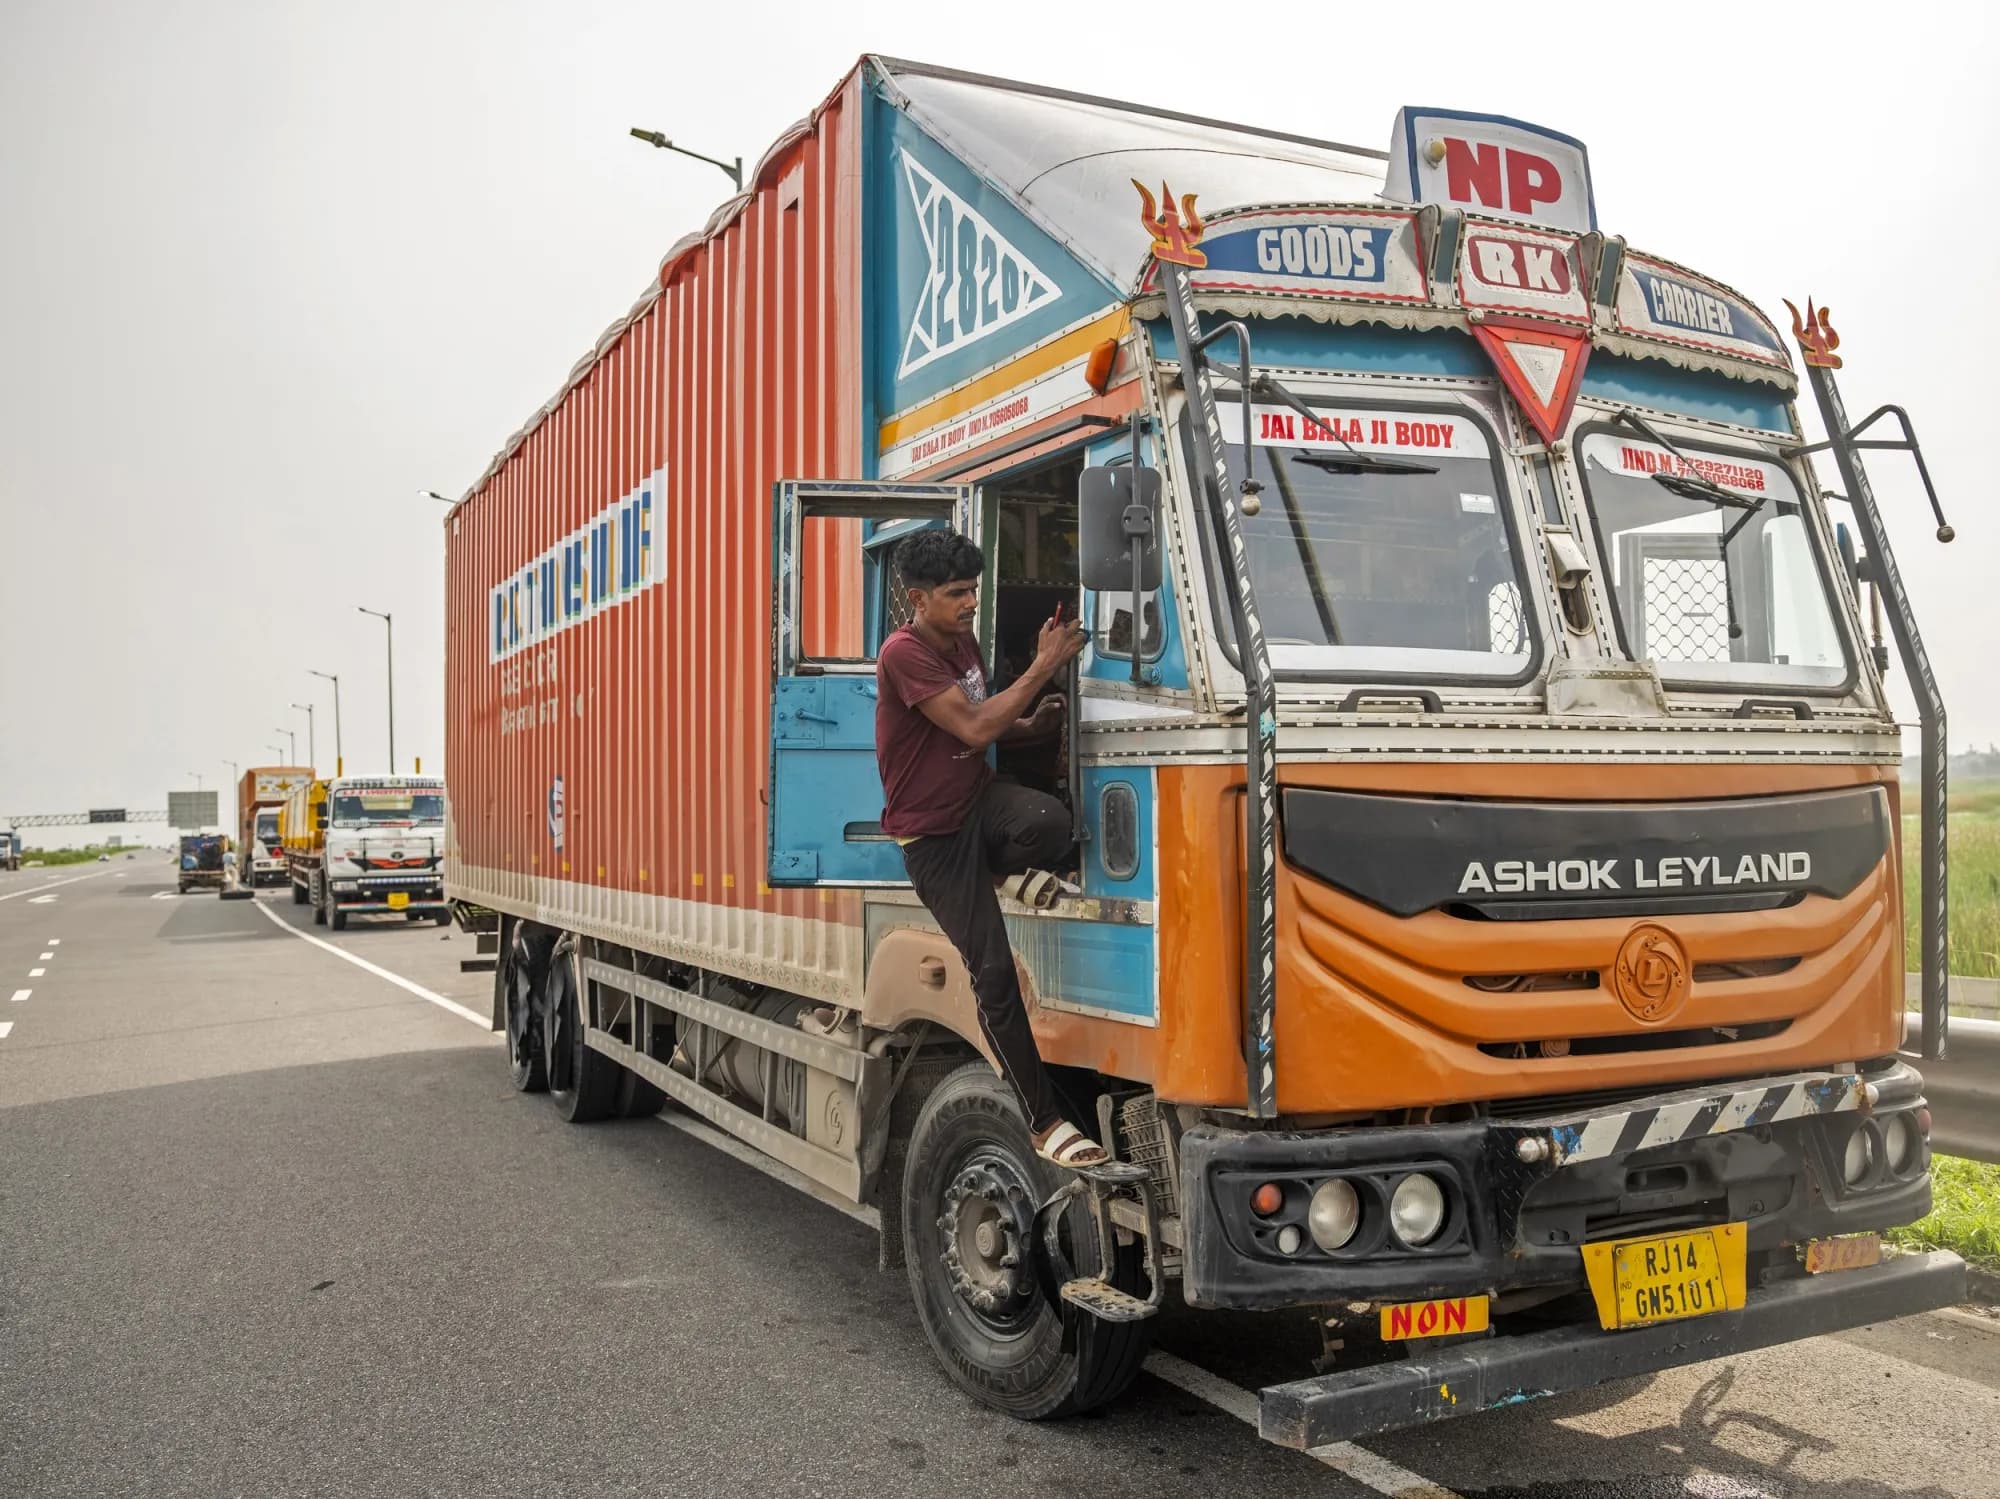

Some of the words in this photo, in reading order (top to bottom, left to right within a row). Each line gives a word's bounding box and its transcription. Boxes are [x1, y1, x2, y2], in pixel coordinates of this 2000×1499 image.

[1443, 137, 1562, 214] NP
[1257, 226, 1376, 278] GOODS
[1475, 240, 1562, 291] RK
[1650, 277, 1734, 335] CARRIER
[948, 424, 966, 447] BODY
[1261, 413, 1296, 440] JAI
[1301, 415, 1364, 443] BALA
[1370, 420, 1388, 445] JI
[1395, 421, 1454, 449] BODY
[1621, 446, 1657, 474] JIND
[1458, 859, 1621, 893] ASHOK
[1635, 852, 1811, 888] LEYLAND
[1645, 1240, 1697, 1276] RJ14
[1391, 1298, 1467, 1338] NON
[1636, 1279, 1716, 1318] GN5101
